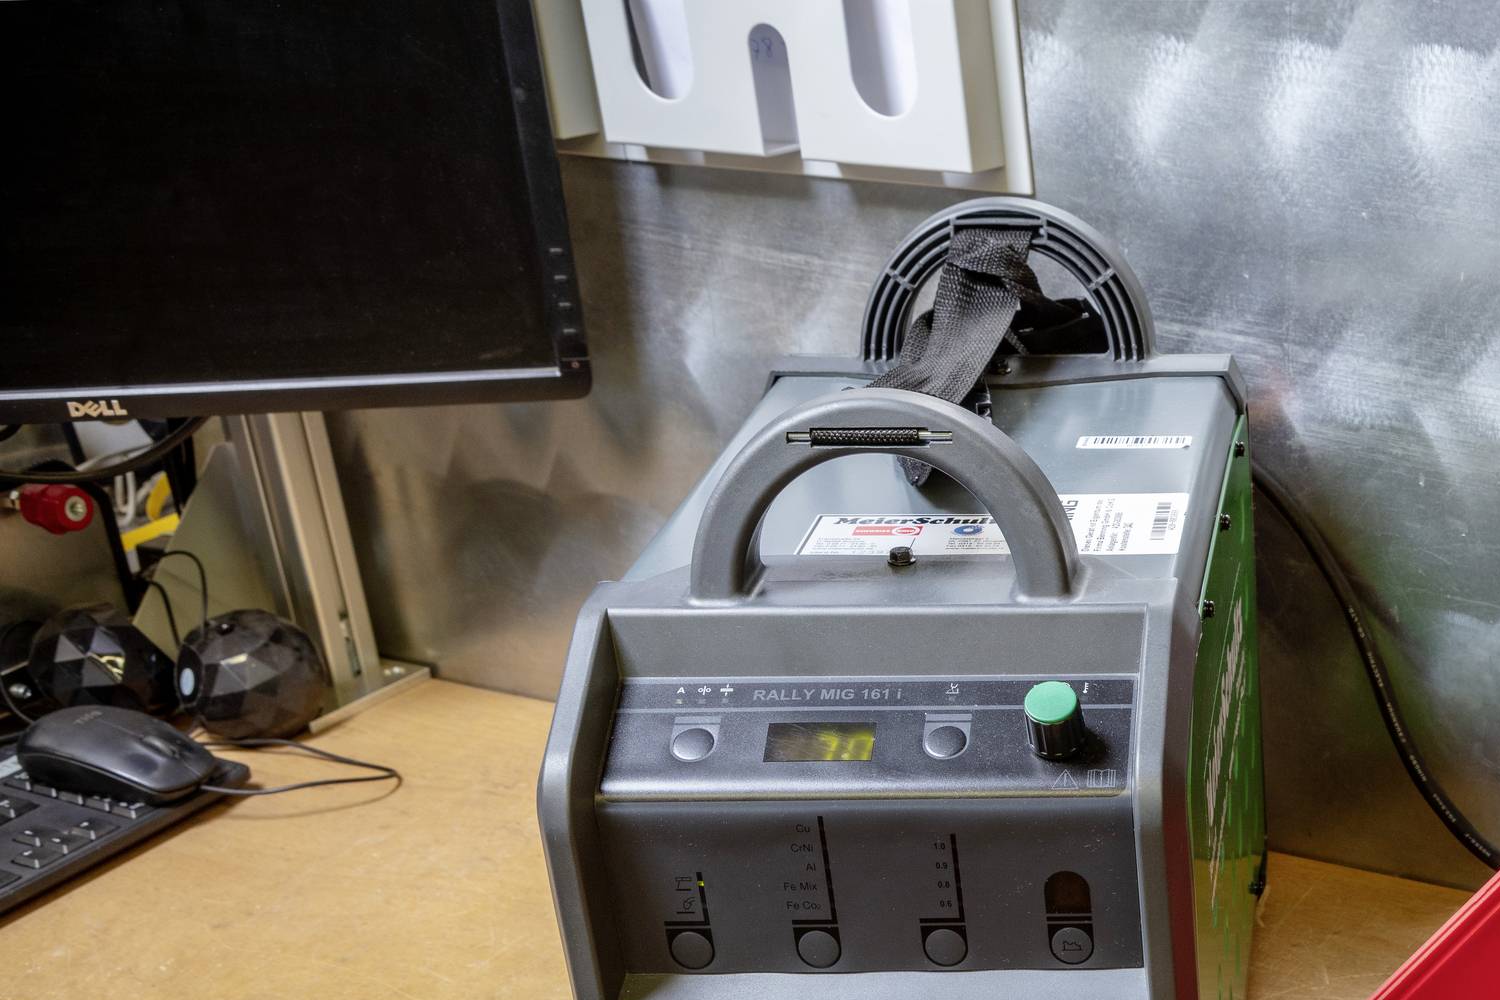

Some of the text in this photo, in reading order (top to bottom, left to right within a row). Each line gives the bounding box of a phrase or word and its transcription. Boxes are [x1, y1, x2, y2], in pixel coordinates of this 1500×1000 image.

[66, 400, 129, 418] DELL
[752, 689, 816, 701] RALLY
[820, 688, 855, 700] MIG
[861, 688, 889, 700] 161
[790, 843, 814, 853] CrNi
[935, 861, 948, 869] 0.9
[783, 882, 818, 891] Fe Mix
[786, 901, 800, 910] Fe
